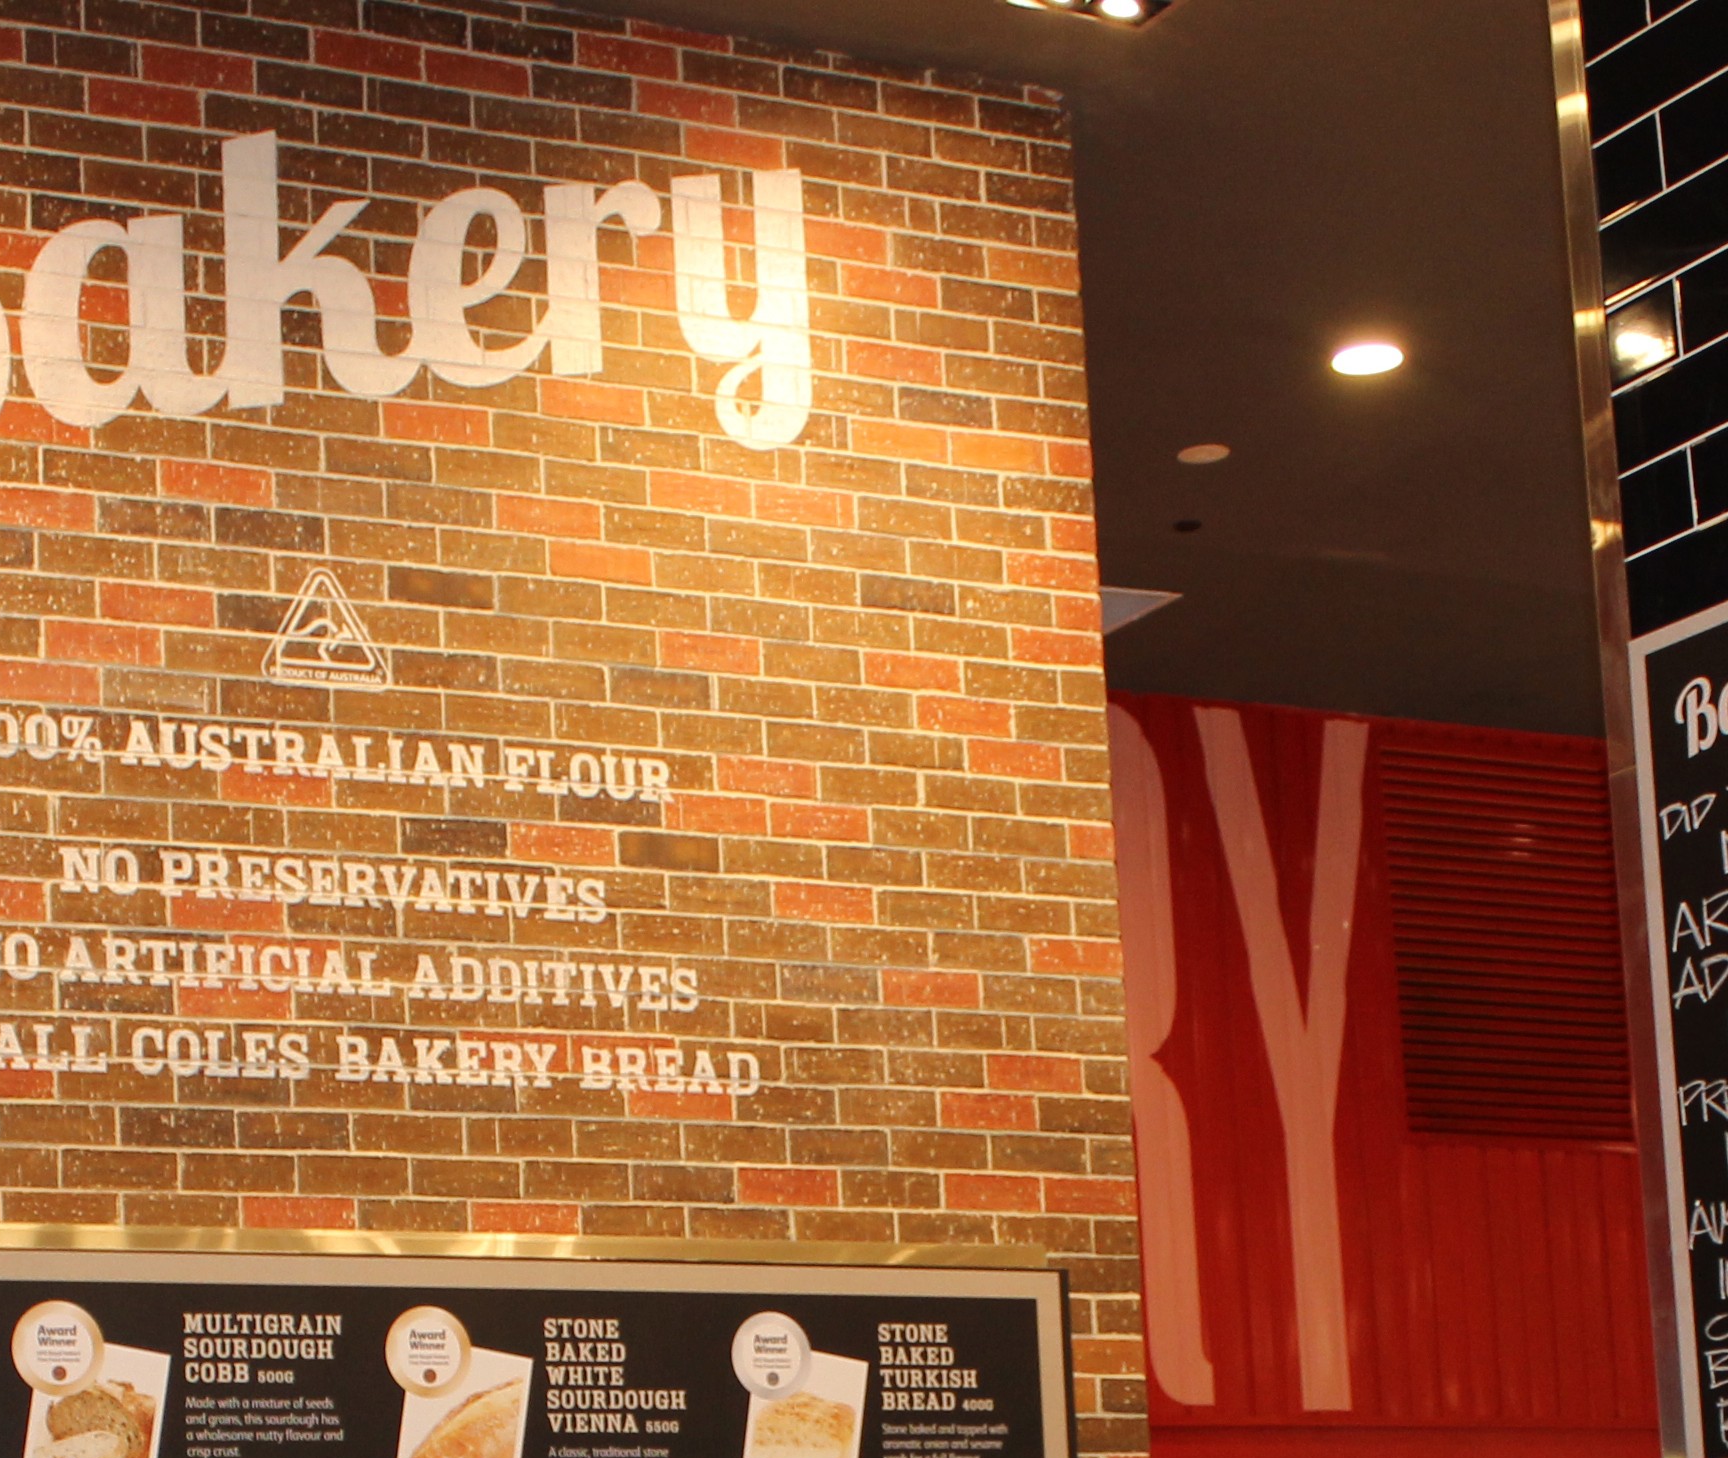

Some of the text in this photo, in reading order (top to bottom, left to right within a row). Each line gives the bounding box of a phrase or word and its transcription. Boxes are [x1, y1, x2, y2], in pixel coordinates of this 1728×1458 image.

[315, 670, 327, 680] OF
[329, 671, 382, 683] AUSTRALIA
[121, 723, 485, 790] AUSTRALIAN
[505, 747, 674, 803] FLOUR
[1659, 793, 1717, 840] DID
[60, 847, 608, 923] NO PRESERVATIVES
[60, 938, 391, 998] ARTIFICIAL
[408, 956, 700, 1012] ADDITIVES
[131, 1027, 309, 1080] COLES
[335, 1035, 558, 1091] BAKERY
[579, 1045, 760, 1097] BREAD
[38, 1325, 77, 1338] Award
[183, 1313, 342, 1336] MULTIGRAIN
[544, 1318, 619, 1339] STONE
[878, 1323, 948, 1343] STONE
[38, 1336, 77, 1348] Winner
[409, 1330, 446, 1341] Award
[409, 1340, 446, 1351] Winner
[184, 1339, 334, 1360] SOURDOUGH
[545, 1342, 626, 1362] BAKED
[880, 1346, 955, 1366] BAKED
[185, 1363, 249, 1383] COBB
[546, 1366, 624, 1386] WHITE
[880, 1370, 977, 1389] TURKISH
[547, 1390, 686, 1410] SOURDOUGH
[882, 1392, 956, 1411] BREAD
[547, 1413, 639, 1433] VIENNA
